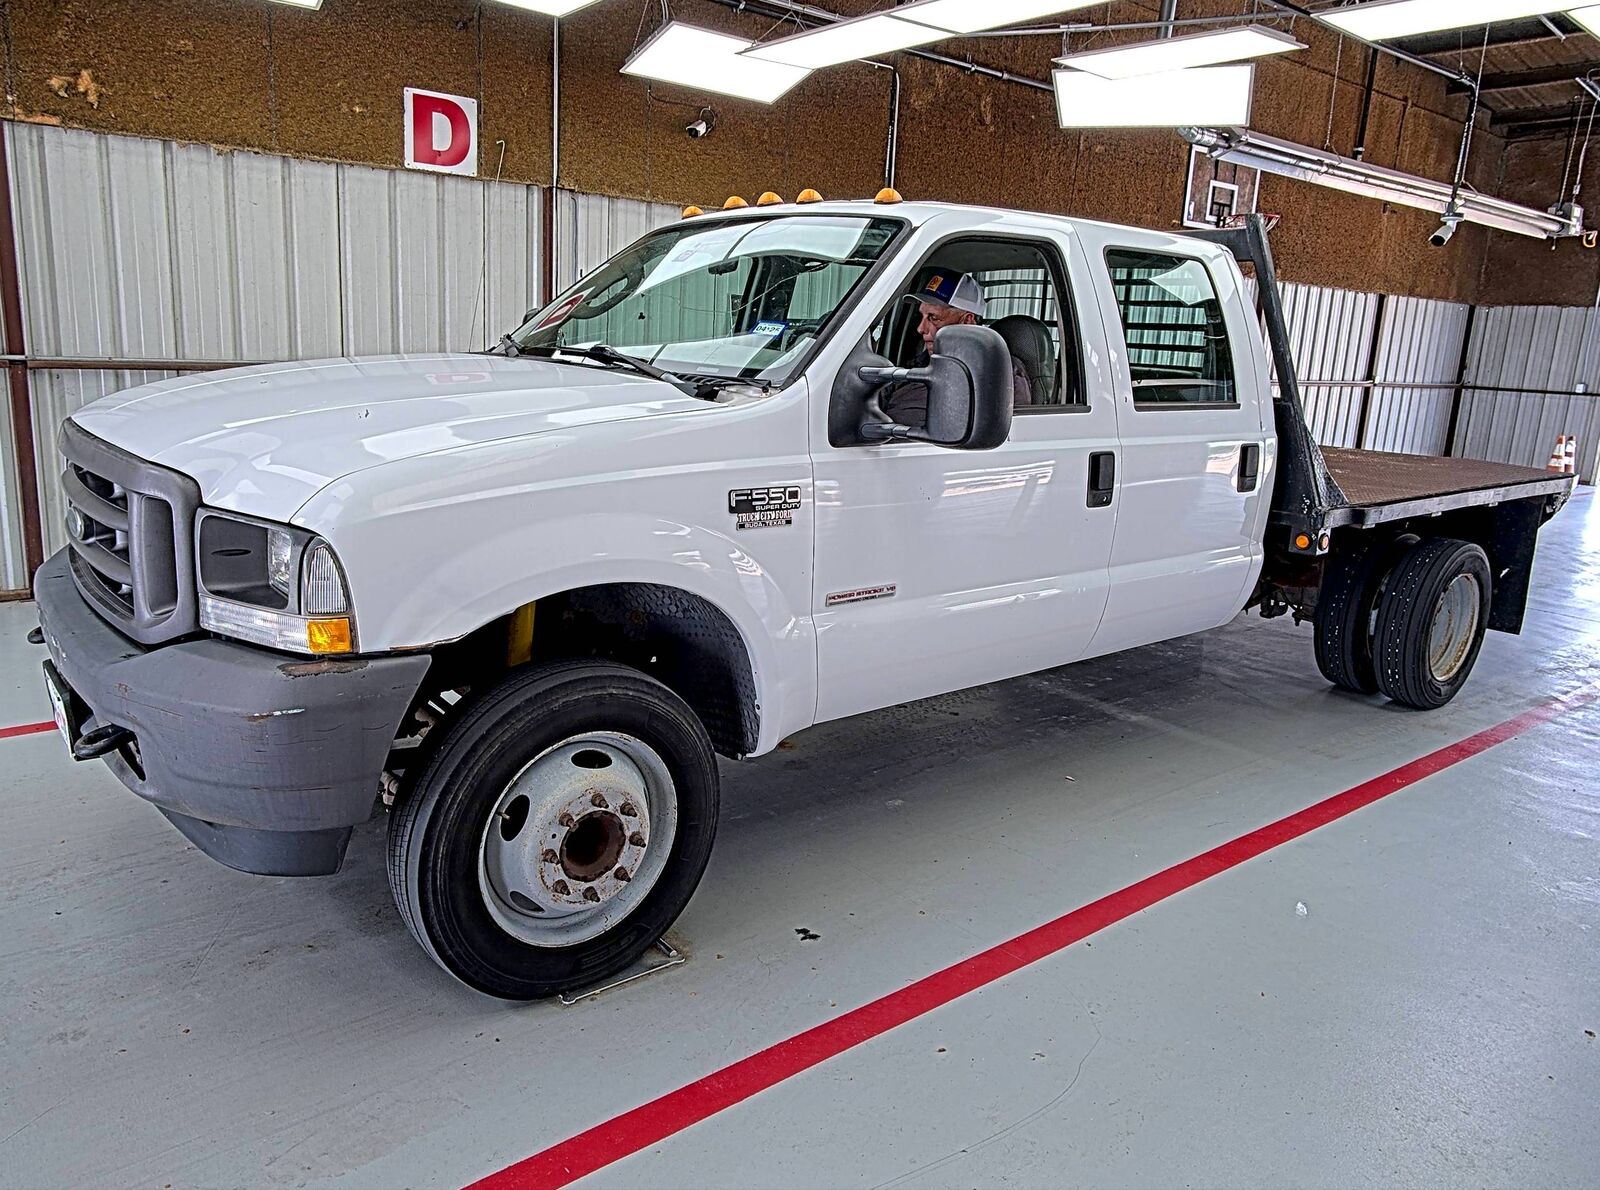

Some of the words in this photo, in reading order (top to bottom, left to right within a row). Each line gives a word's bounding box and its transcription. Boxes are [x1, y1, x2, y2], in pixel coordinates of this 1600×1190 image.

[413, 93, 471, 167] D
[738, 512, 760, 523] TRUCK
[760, 511, 776, 521] CITY
[775, 510, 793, 519] FORD
[828, 592, 855, 601] POWER
